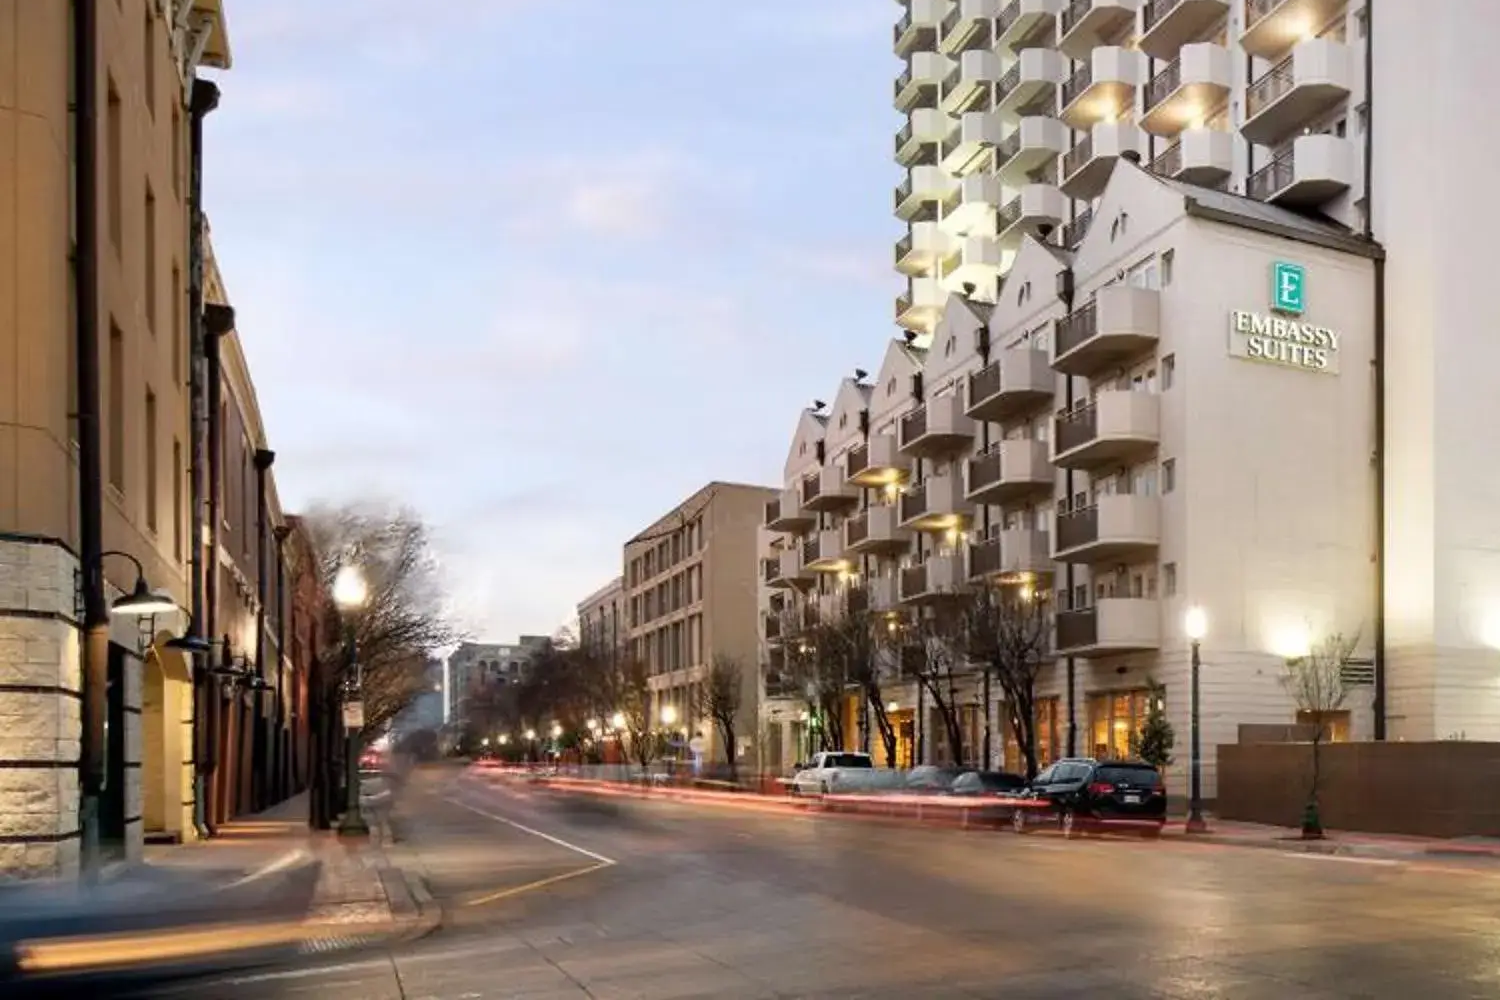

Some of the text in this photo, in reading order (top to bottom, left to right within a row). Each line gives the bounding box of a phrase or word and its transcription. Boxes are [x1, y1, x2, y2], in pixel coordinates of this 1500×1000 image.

[1280, 271, 1300, 304] E
[1236, 311, 1341, 350] EMBASSY
[1248, 336, 1328, 369] SUITES
